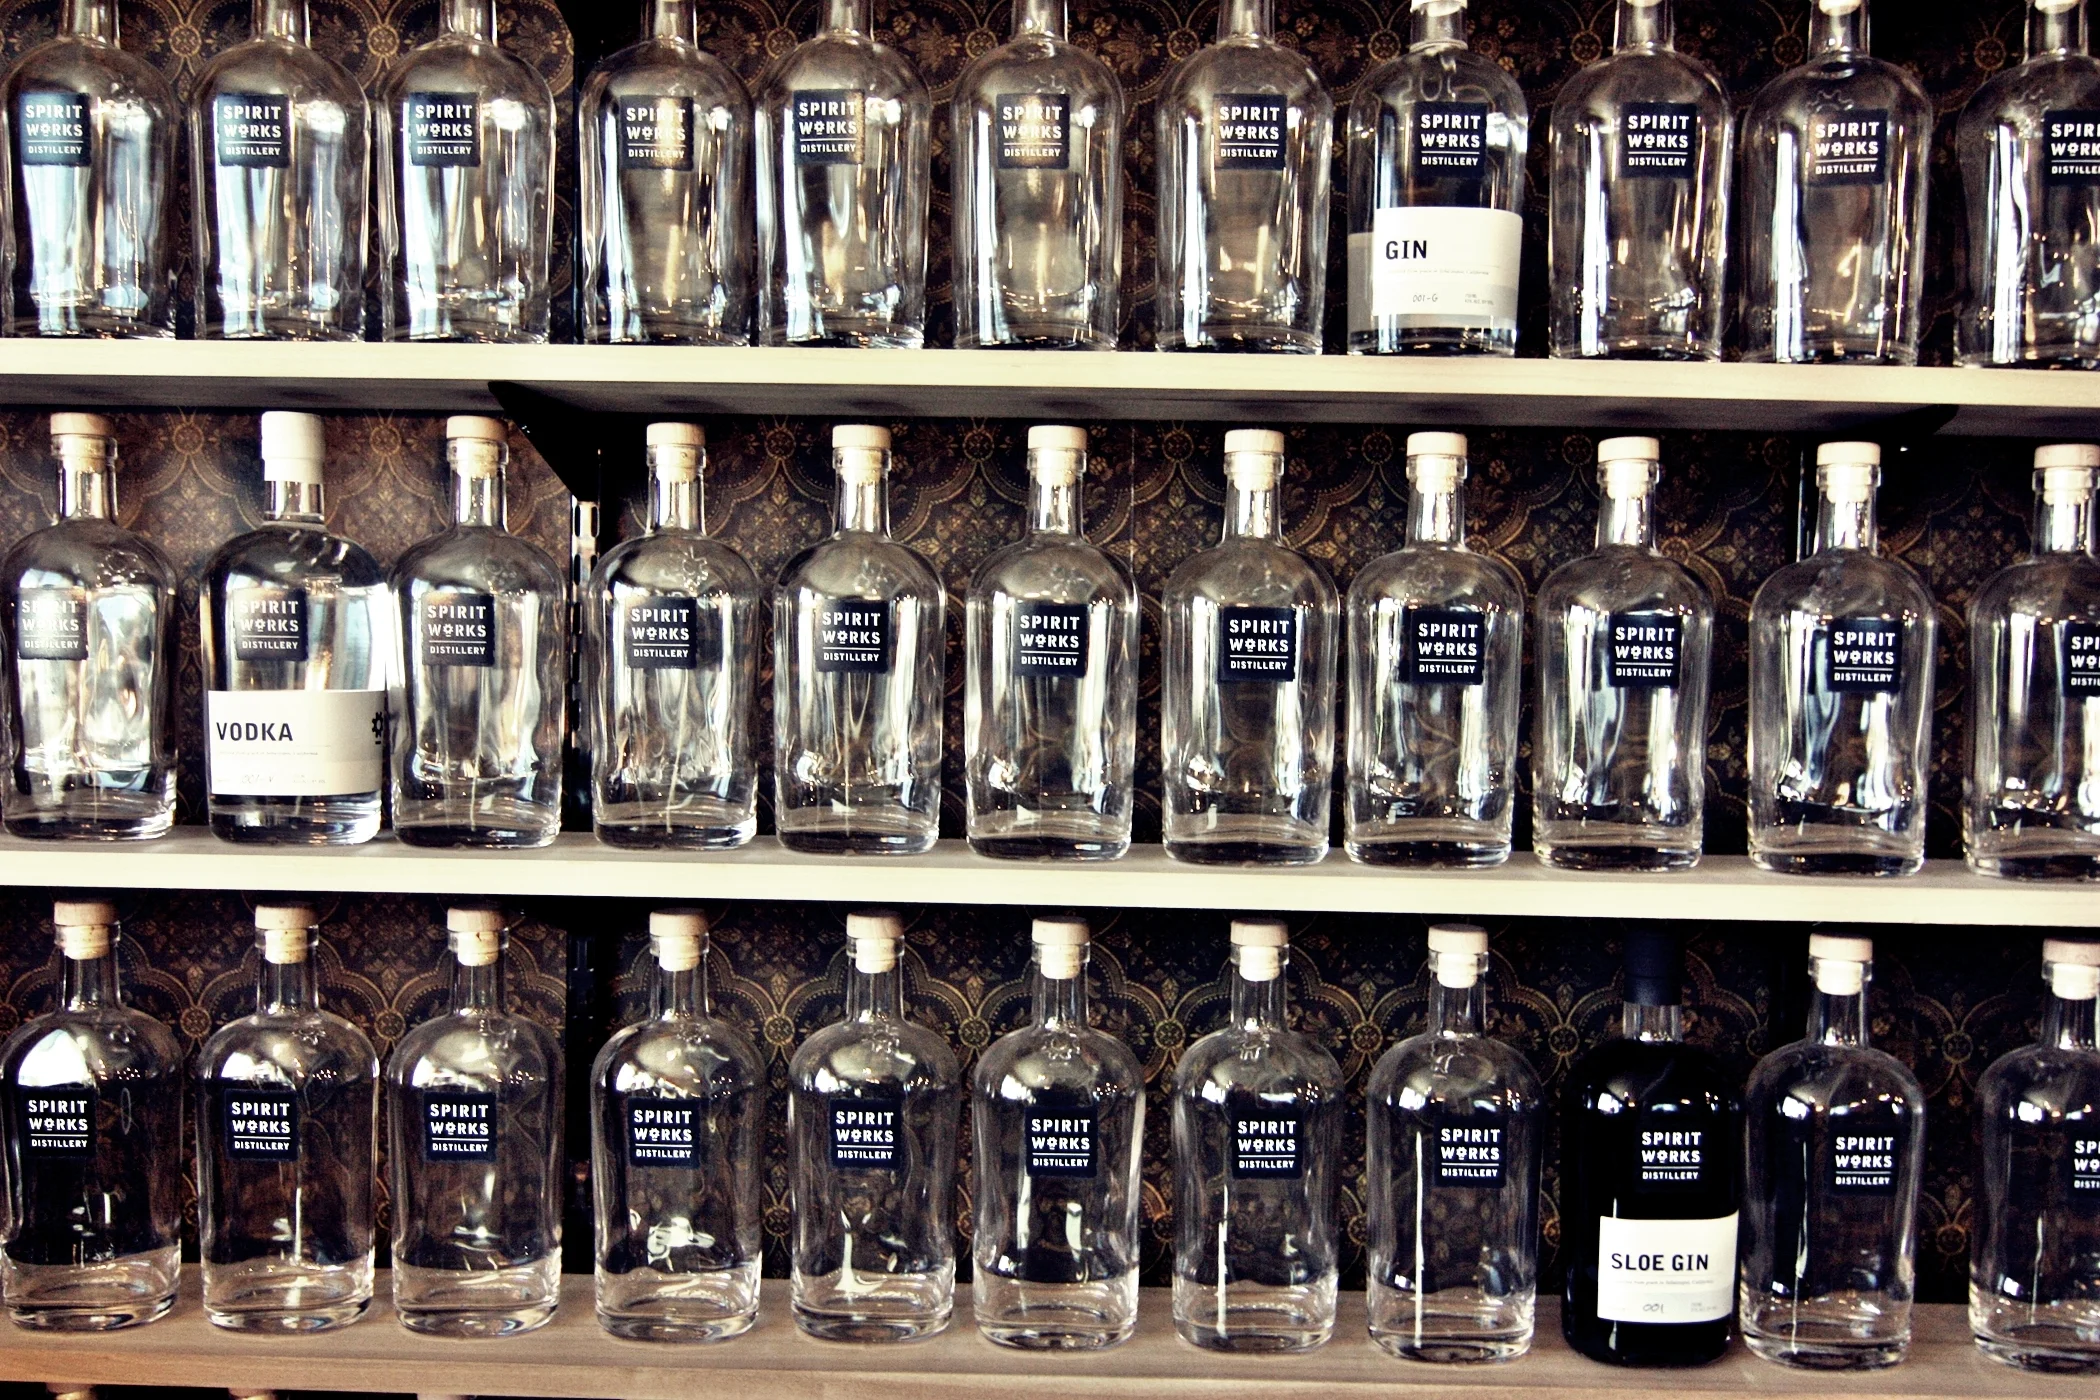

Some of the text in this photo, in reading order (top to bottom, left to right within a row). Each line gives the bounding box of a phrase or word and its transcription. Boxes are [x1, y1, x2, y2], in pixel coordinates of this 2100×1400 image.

[25, 104, 84, 119] SPIRIT
[223, 105, 281, 119] SPIRIT
[415, 104, 474, 119] SPIRIT
[626, 107, 686, 122] SPIT
[799, 102, 859, 117] SPIRIT
[1219, 106, 1281, 121] SPIRIT
[799, 121, 859, 135] WORKS
[1420, 115, 1481, 129] SPIRIT
[1627, 115, 1690, 129] SPIRIT
[25, 124, 83, 137] WORKS
[223, 124, 282, 138] WORKS
[415, 123, 474, 137] WORKS
[626, 126, 686, 140] WORS
[1219, 126, 1280, 140] WORKS
[1815, 122, 1880, 138] SPIRIT
[1420, 134, 1481, 148] WORKS
[1627, 134, 1689, 148] WORKS
[27, 145, 82, 155] DISTILLERY
[225, 145, 281, 156] DISTILLERY
[416, 144, 473, 155] DISTILLERY
[800, 143, 858, 154] DISTILLERY
[1004, 148, 1061, 157] DISTILLERY
[1220, 148, 1278, 158] DISTILLERY
[1815, 141, 1879, 156] WORKS
[1421, 156, 1479, 166] DISTILLERY
[1628, 157, 1687, 167] DISTILLERY
[1815, 164, 1877, 175] DISTILLERY
[1385, 240, 1427, 260] GIN
[240, 601, 299, 614] SPIRIT
[427, 605, 488, 620] SPIRIT
[631, 609, 691, 623] SPIRIT
[821, 612, 881, 626] SPIRIT
[1019, 615, 1081, 630] SPIRIT
[22, 619, 79, 631] WRKS
[240, 619, 299, 632] WORKS
[427, 624, 487, 638] WORKS
[1229, 620, 1290, 634] SPIRIT
[1418, 623, 1479, 637] SPIRIT
[631, 627, 690, 641] WORKS
[822, 630, 881, 644] WORKS
[1019, 634, 1080, 648] WORKS
[1615, 627, 1675, 641] SPIRIT
[1833, 632, 1896, 646] SPIRIT
[242, 641, 298, 650] DISTILLERY
[429, 645, 486, 655] DISTILLERY
[1229, 639, 1289, 653] WORKS
[1418, 642, 1478, 656] WORKS
[633, 648, 689, 658] DISTILLERY
[822, 651, 880, 661] DISTILLERY
[1614, 646, 1674, 660] WORKS
[1833, 651, 1895, 665] WORKS
[1020, 656, 1078, 666] DISTILLERY
[1230, 660, 1287, 670] DISTILLERY
[2071, 655, 2100, 669] WO
[1418, 664, 1476, 674] DISTILLERY
[1615, 668, 1672, 678] DISTILLERY
[1834, 673, 1893, 683] DISTILLERY
[216, 722, 293, 741] VODKA
[28, 1100, 88, 1114] SPIRIT
[231, 1102, 290, 1116] SPIRIT
[430, 1104, 489, 1118] SPIRIT
[633, 1110, 692, 1124] SPIRIT
[835, 1111, 894, 1125] SPIRIT
[28, 1118, 88, 1131] WORKS
[231, 1120, 291, 1134] WORKS
[430, 1122, 489, 1136] WORKS
[1031, 1119, 1091, 1133] SPIRIT
[1237, 1121, 1297, 1135] SPIRIT
[634, 1128, 693, 1142] WORKS
[835, 1129, 894, 1143] WORKS
[1440, 1129, 1501, 1143] SPIRIT
[1641, 1132, 1702, 1146] SPIRIT
[31, 1138, 88, 1148] DISTILLERY
[234, 1141, 290, 1151] DISTILLERY
[432, 1142, 488, 1152] DISTILLERY
[1031, 1137, 1090, 1151] WORKS
[1237, 1139, 1296, 1153] WORKS
[1835, 1137, 1894, 1151] SPIRIT
[635, 1149, 692, 1159] DISTILLERY
[837, 1150, 893, 1160] DISTILLERY
[1440, 1147, 1500, 1161] WORKS
[1641, 1150, 1701, 1164] WORKS
[1032, 1157, 1089, 1167] DISTILLERY
[1238, 1160, 1295, 1169] DISTILLERY
[1835, 1155, 1893, 1169] WORKS
[1441, 1168, 1498, 1178] DISTILLERY
[1642, 1171, 1699, 1180] DISTILLERY
[1835, 1176, 1890, 1186] DISTILLERY
[1611, 1253, 1708, 1271] SLOE GIN
